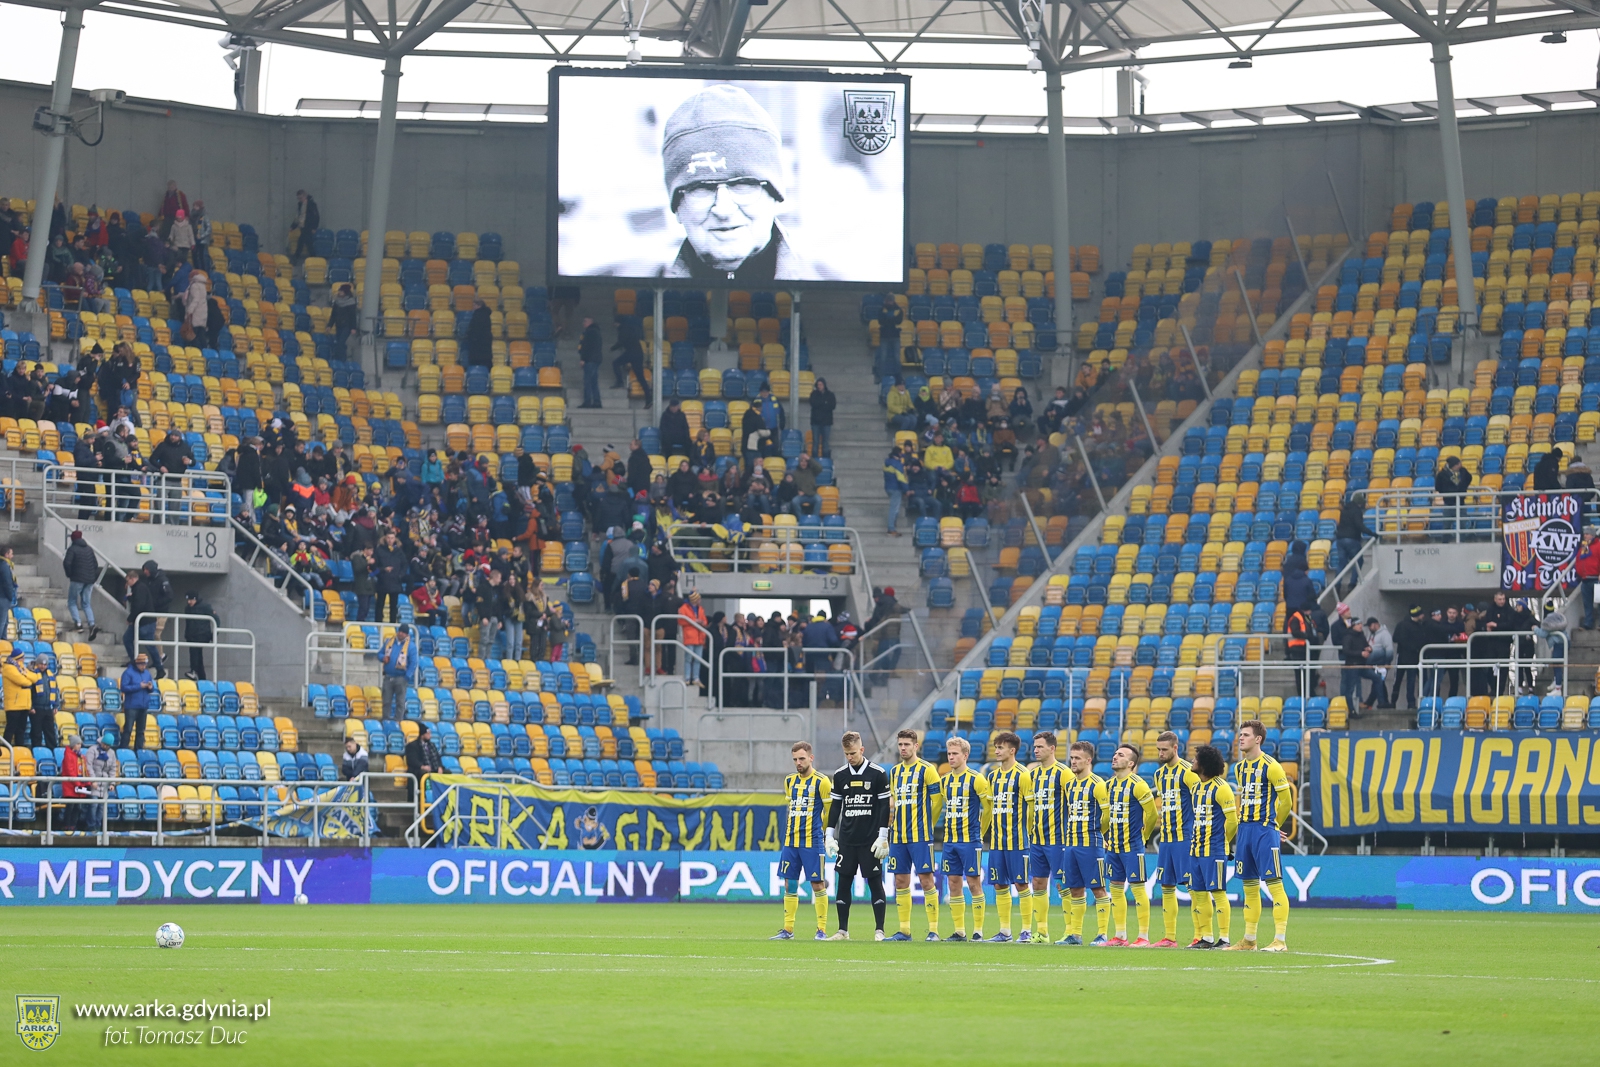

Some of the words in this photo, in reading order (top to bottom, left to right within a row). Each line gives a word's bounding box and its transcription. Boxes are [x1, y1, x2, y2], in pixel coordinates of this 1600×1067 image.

[854, 125, 886, 133] ARKA
[1506, 496, 1578, 521] Kleinfeld
[82, 524, 104, 533] SEKTOR
[1507, 520, 1537, 531] POLONIA
[194, 532, 217, 559] 18
[1414, 548, 1440, 556] SEKTOR
[1529, 530, 1581, 552] KNF
[822, 576, 839, 590] 19
[441, 789, 569, 850] ARKA
[615, 808, 782, 852] GDYNIA
[38, 859, 315, 898] MEDYCZNY
[427, 860, 664, 896] OFICJALNY
[1470, 867, 1600, 906] OFIC
